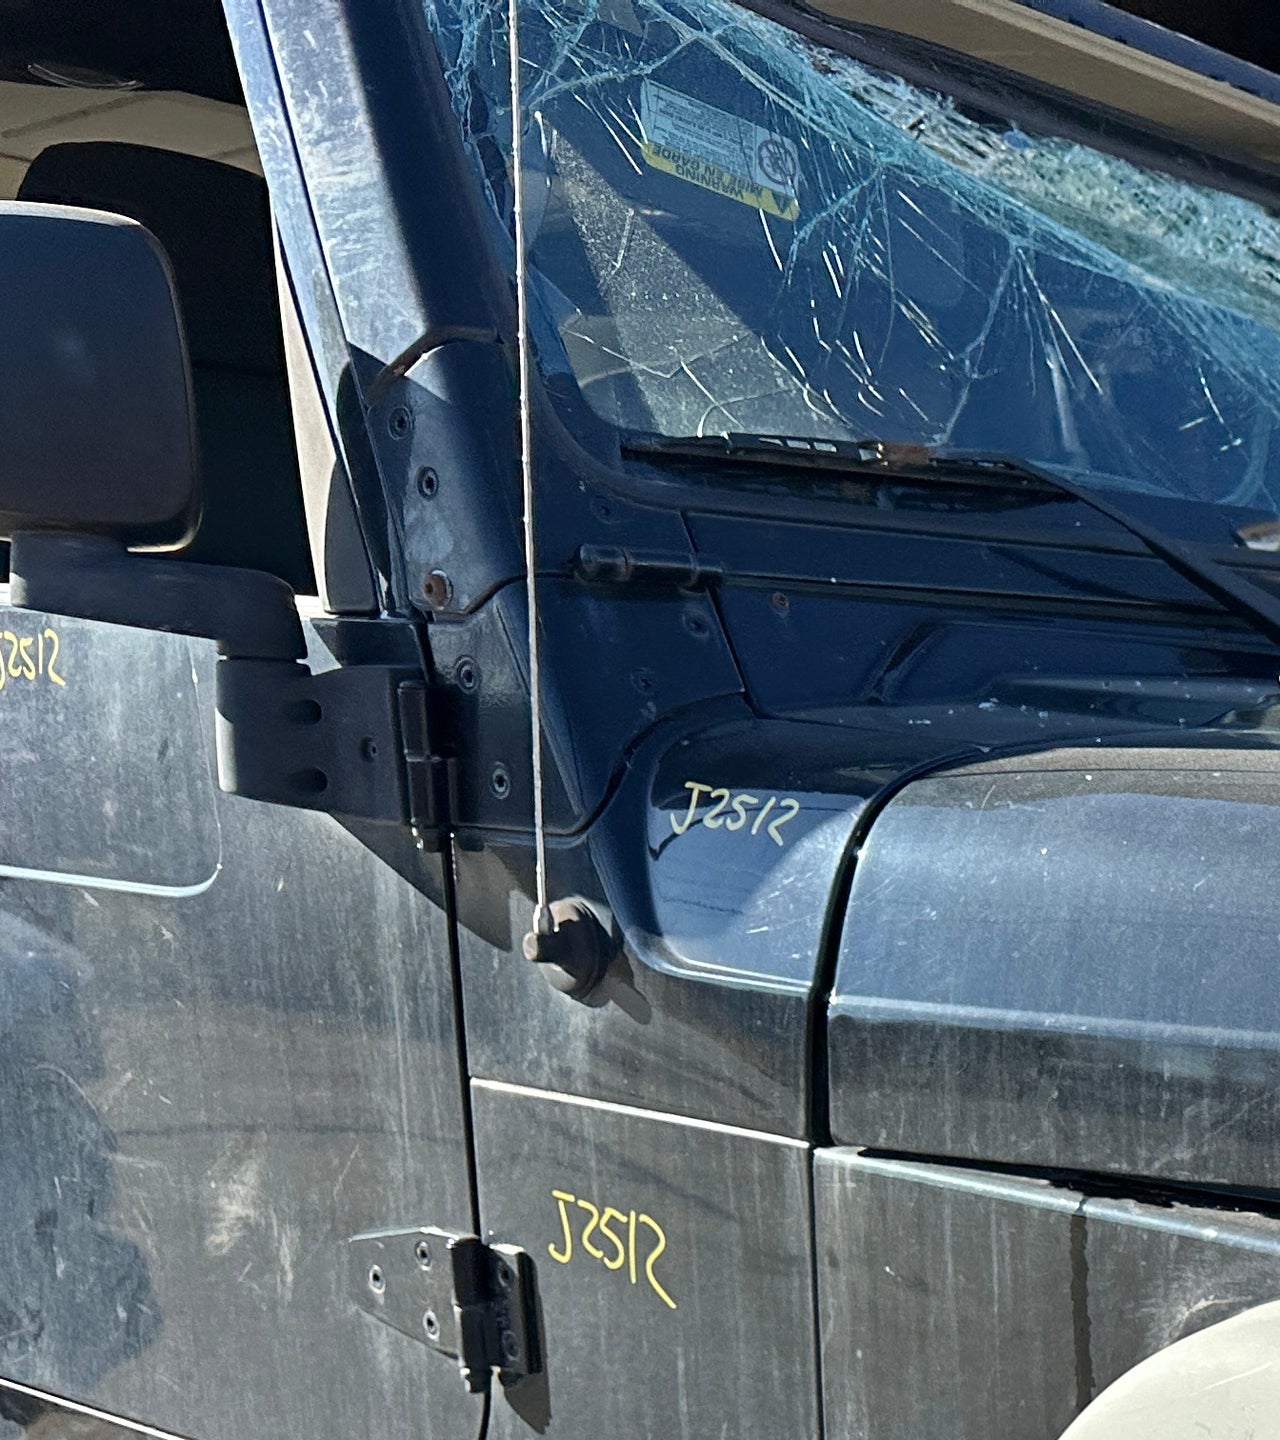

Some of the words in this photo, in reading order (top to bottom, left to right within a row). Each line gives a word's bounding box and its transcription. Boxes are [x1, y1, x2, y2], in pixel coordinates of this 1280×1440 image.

[652, 142, 701, 171] GARDE
[704, 164, 724, 180] EN
[675, 163, 744, 200] WARNING
[729, 174, 764, 197] MISE
[670, 781, 800, 846] J2512
[548, 1189, 677, 1308] J2512
